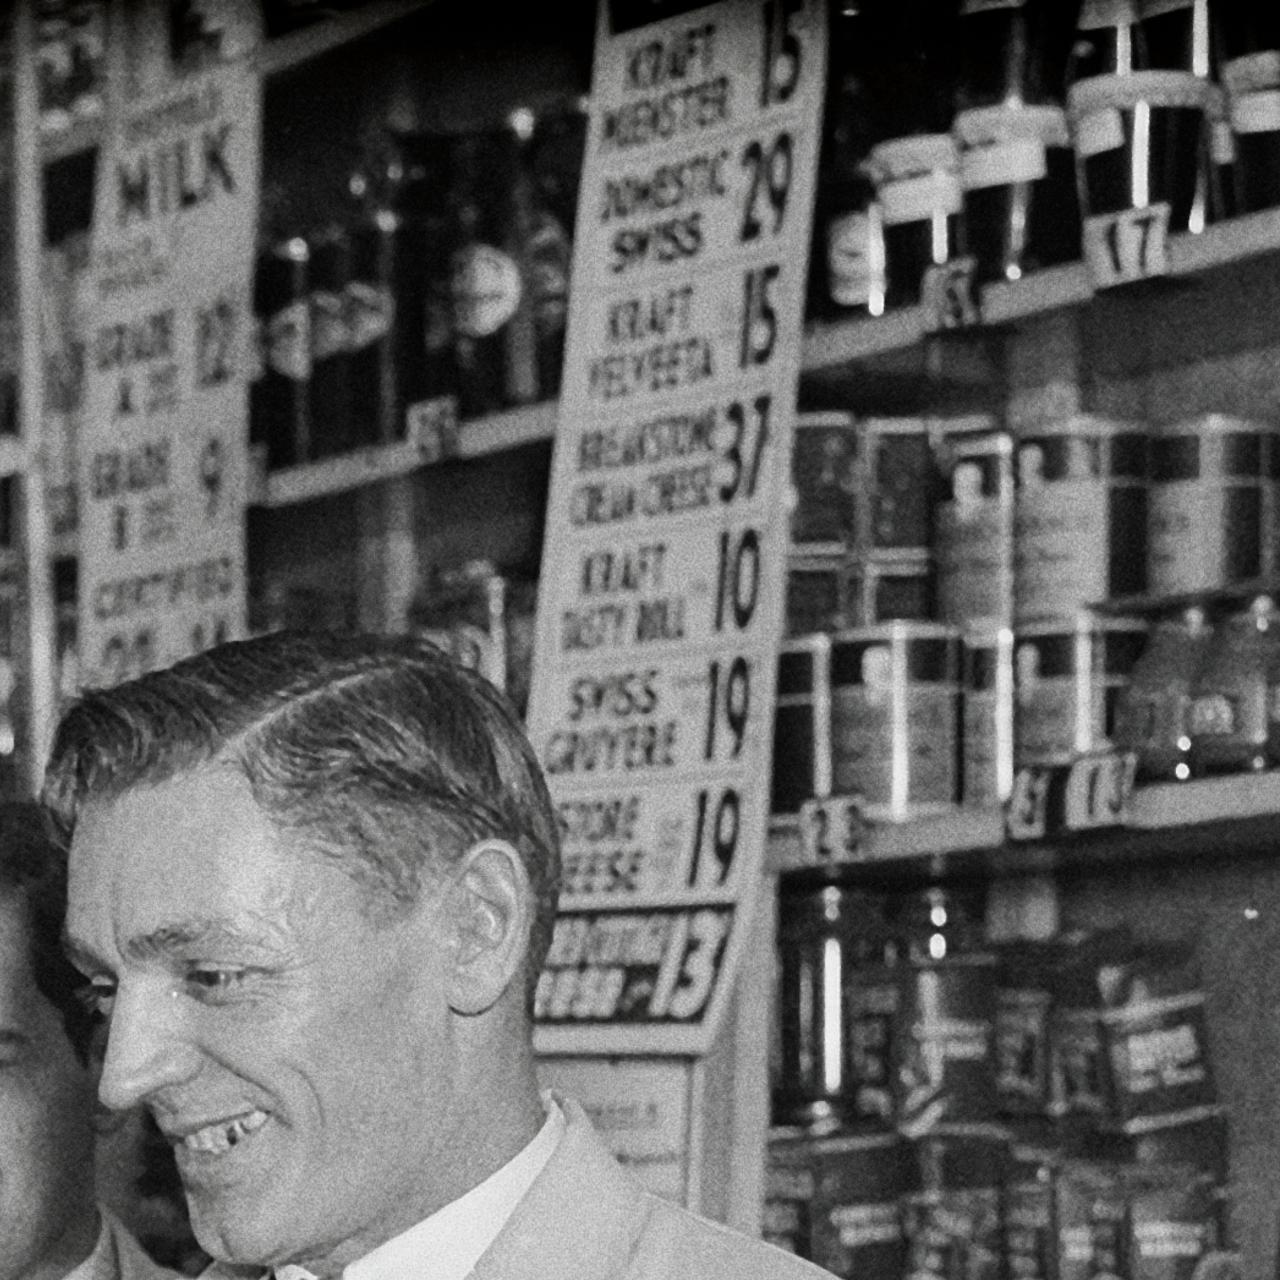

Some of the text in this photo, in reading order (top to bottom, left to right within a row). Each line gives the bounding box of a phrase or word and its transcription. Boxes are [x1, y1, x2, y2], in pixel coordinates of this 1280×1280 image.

[622, 23, 717, 90] KRAFT
[758, 0, 803, 109] 15
[602, 76, 730, 146] MUENSTER
[114, 122, 238, 228] MILK
[601, 149, 730, 224] DOMESTIC
[740, 131, 791, 242] 29
[611, 211, 703, 273] SWISS
[606, 283, 694, 343] KRAFT
[739, 264, 781, 369] 15
[589, 337, 713, 402] VELVEETA
[718, 394, 772, 504] 37
[581, 542, 667, 594] KRAFT
[714, 528, 761, 632] 10
[568, 669, 659, 722] SWISS
[704, 656, 750, 760] 19
[543, 720, 677, 775] GRUYERE
[687, 787, 739, 887] 19
[647, 911, 731, 1019] 13
